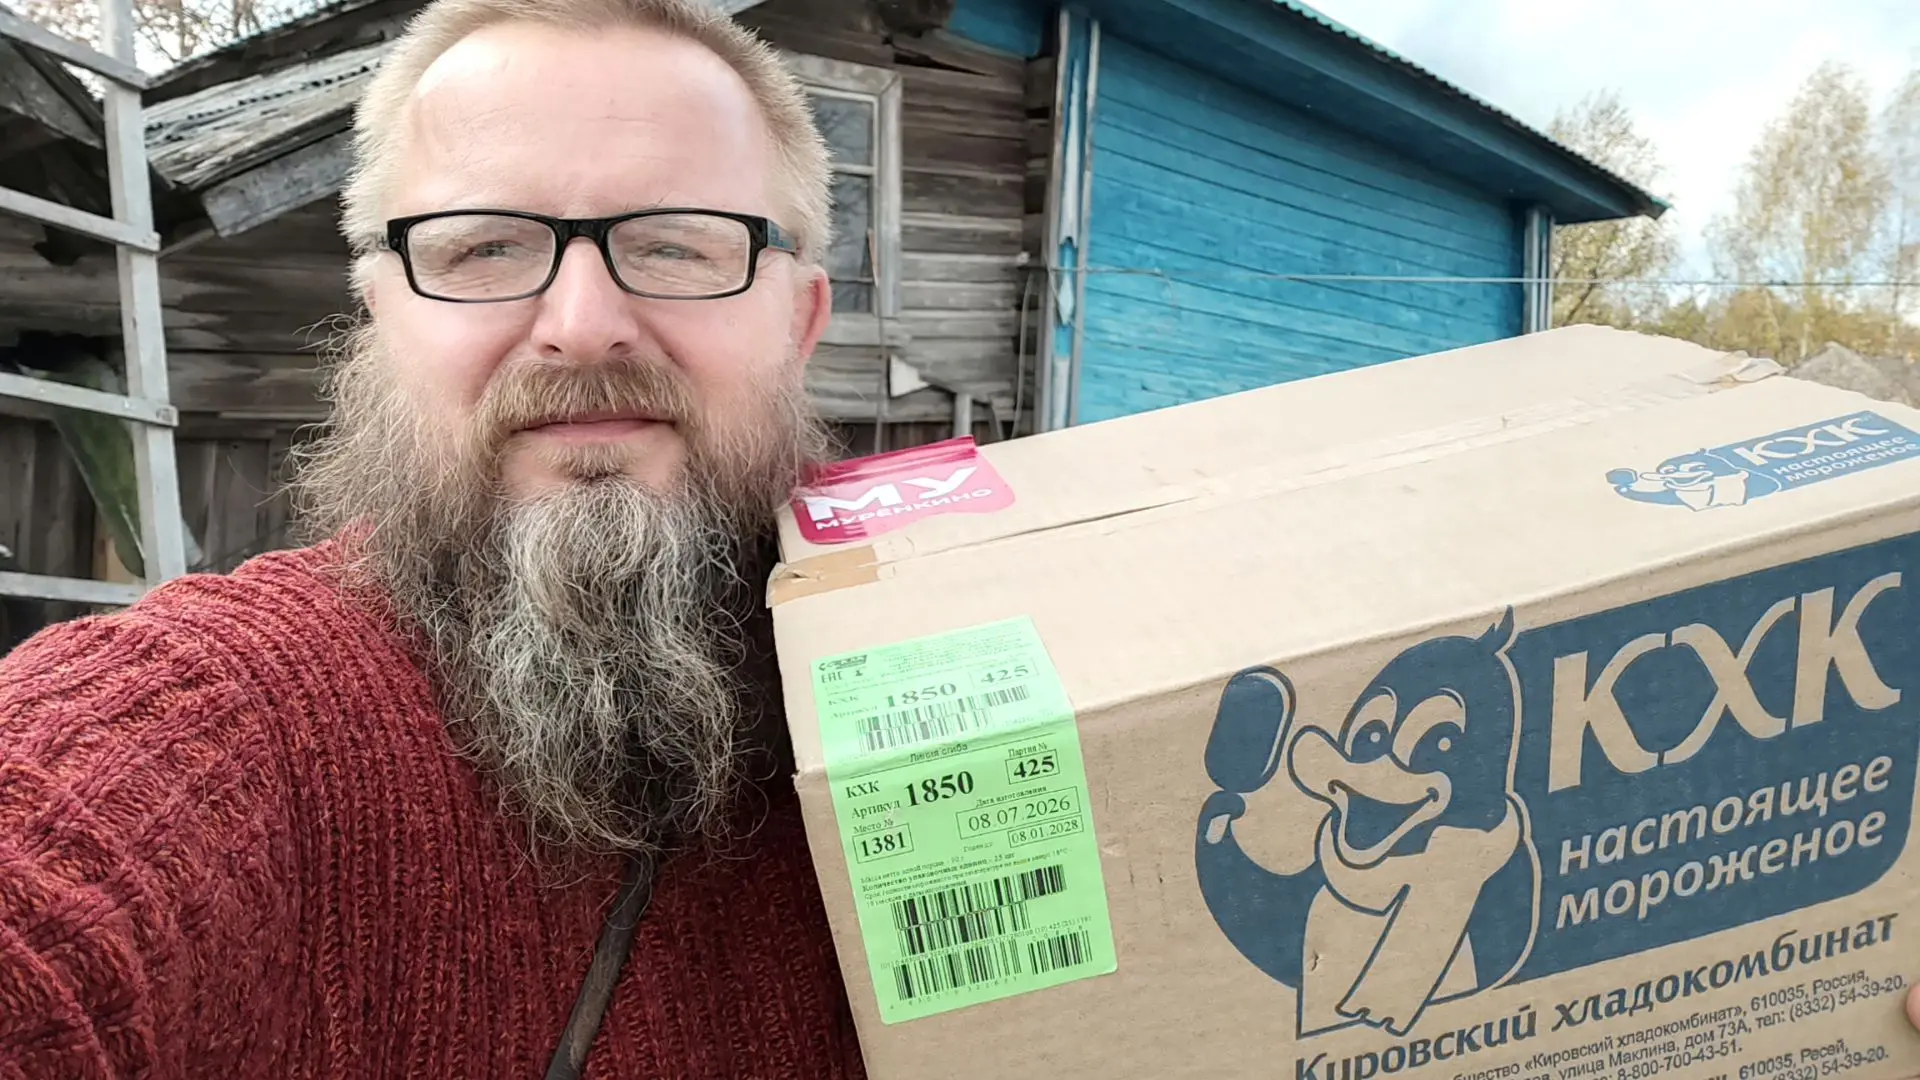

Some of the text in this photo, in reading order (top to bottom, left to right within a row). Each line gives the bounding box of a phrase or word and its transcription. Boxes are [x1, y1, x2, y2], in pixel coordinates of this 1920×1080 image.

[1731, 417, 1890, 466] КХК
[1772, 436, 1908, 475] настоящее
[1784, 443, 1920, 482] мороженое
[803, 466, 978, 521] МУ
[980, 664, 1030, 684] 425
[1548, 571, 1902, 793] КХК
[885, 682, 958, 708] 1850
[1008, 744, 1037, 758] Партия
[1013, 755, 1055, 778] 425
[845, 780, 881, 799] КХК
[851, 770, 974, 820] Артикул 1850
[976, 798, 995, 808] Дата
[853, 822, 882, 834] Место
[968, 795, 1071, 832] 08.07.2026
[1011, 819, 1079, 844] 08.01.2028
[1559, 755, 1894, 875] настоящее
[861, 831, 906, 857] 1381
[1556, 810, 1886, 930] мороженое
[1295, 912, 1899, 1080] Кировский хладокомбинат
[1524, 1034, 1613, 1071] «Кировский
[1750, 984, 1809, 1012] 610035,
[1812, 970, 1870, 996] Россия,
[1558, 1059, 1605, 1080] улица
[1609, 1040, 1680, 1068] Маклина,
[1684, 1030, 1715, 1051] дом
[1755, 1010, 1786, 1030] тел:
[1789, 993, 1836, 1023] (8332)
[1838, 974, 1908, 1006] 54-39-20.
[1739, 1052, 1797, 1080] 610035,
[1821, 1045, 1889, 1076] 54-39-20.
